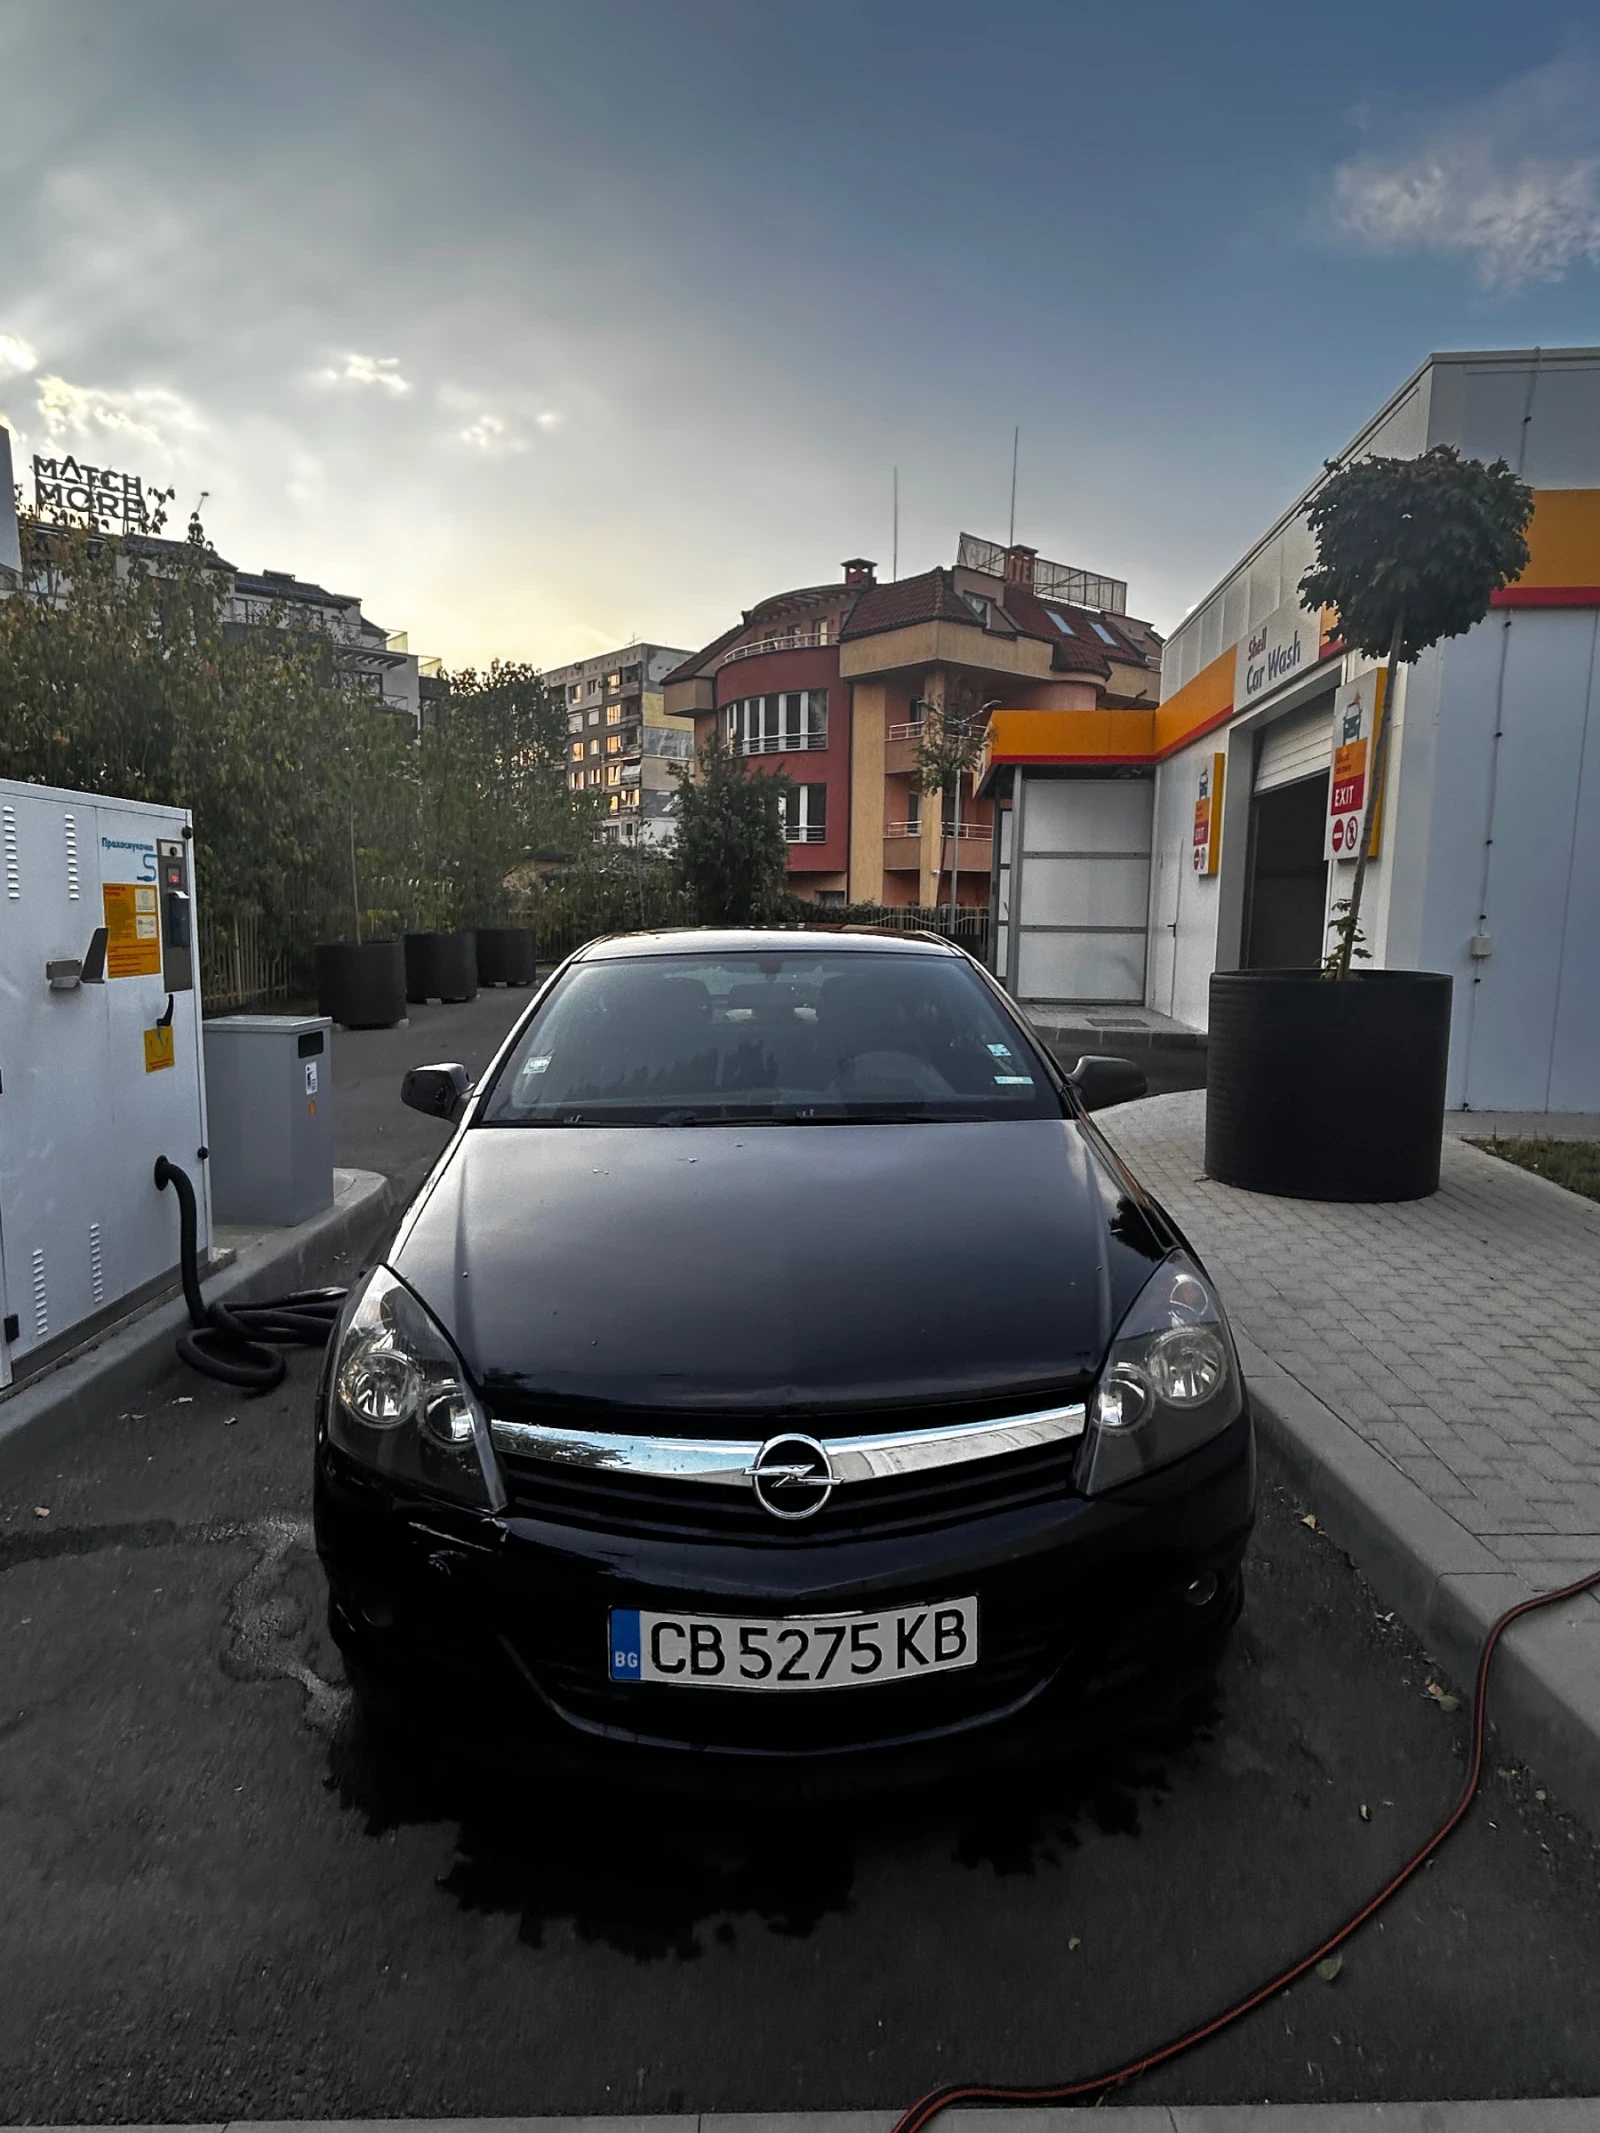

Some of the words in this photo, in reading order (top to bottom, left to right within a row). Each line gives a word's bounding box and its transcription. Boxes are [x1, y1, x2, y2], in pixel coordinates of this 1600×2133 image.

[33, 454, 142, 496] MATCH
[35, 479, 143, 522] MORE
[1247, 665, 1265, 694] Car
[1268, 630, 1300, 681] Wash
[1248, 626, 1267, 661] Shell
[1334, 785, 1354, 807] EXIT
[614, 1652, 638, 1668] BG
[650, 1621, 726, 1675] CB
[739, 1622, 883, 1680] 5275
[897, 1608, 967, 1669] KB
